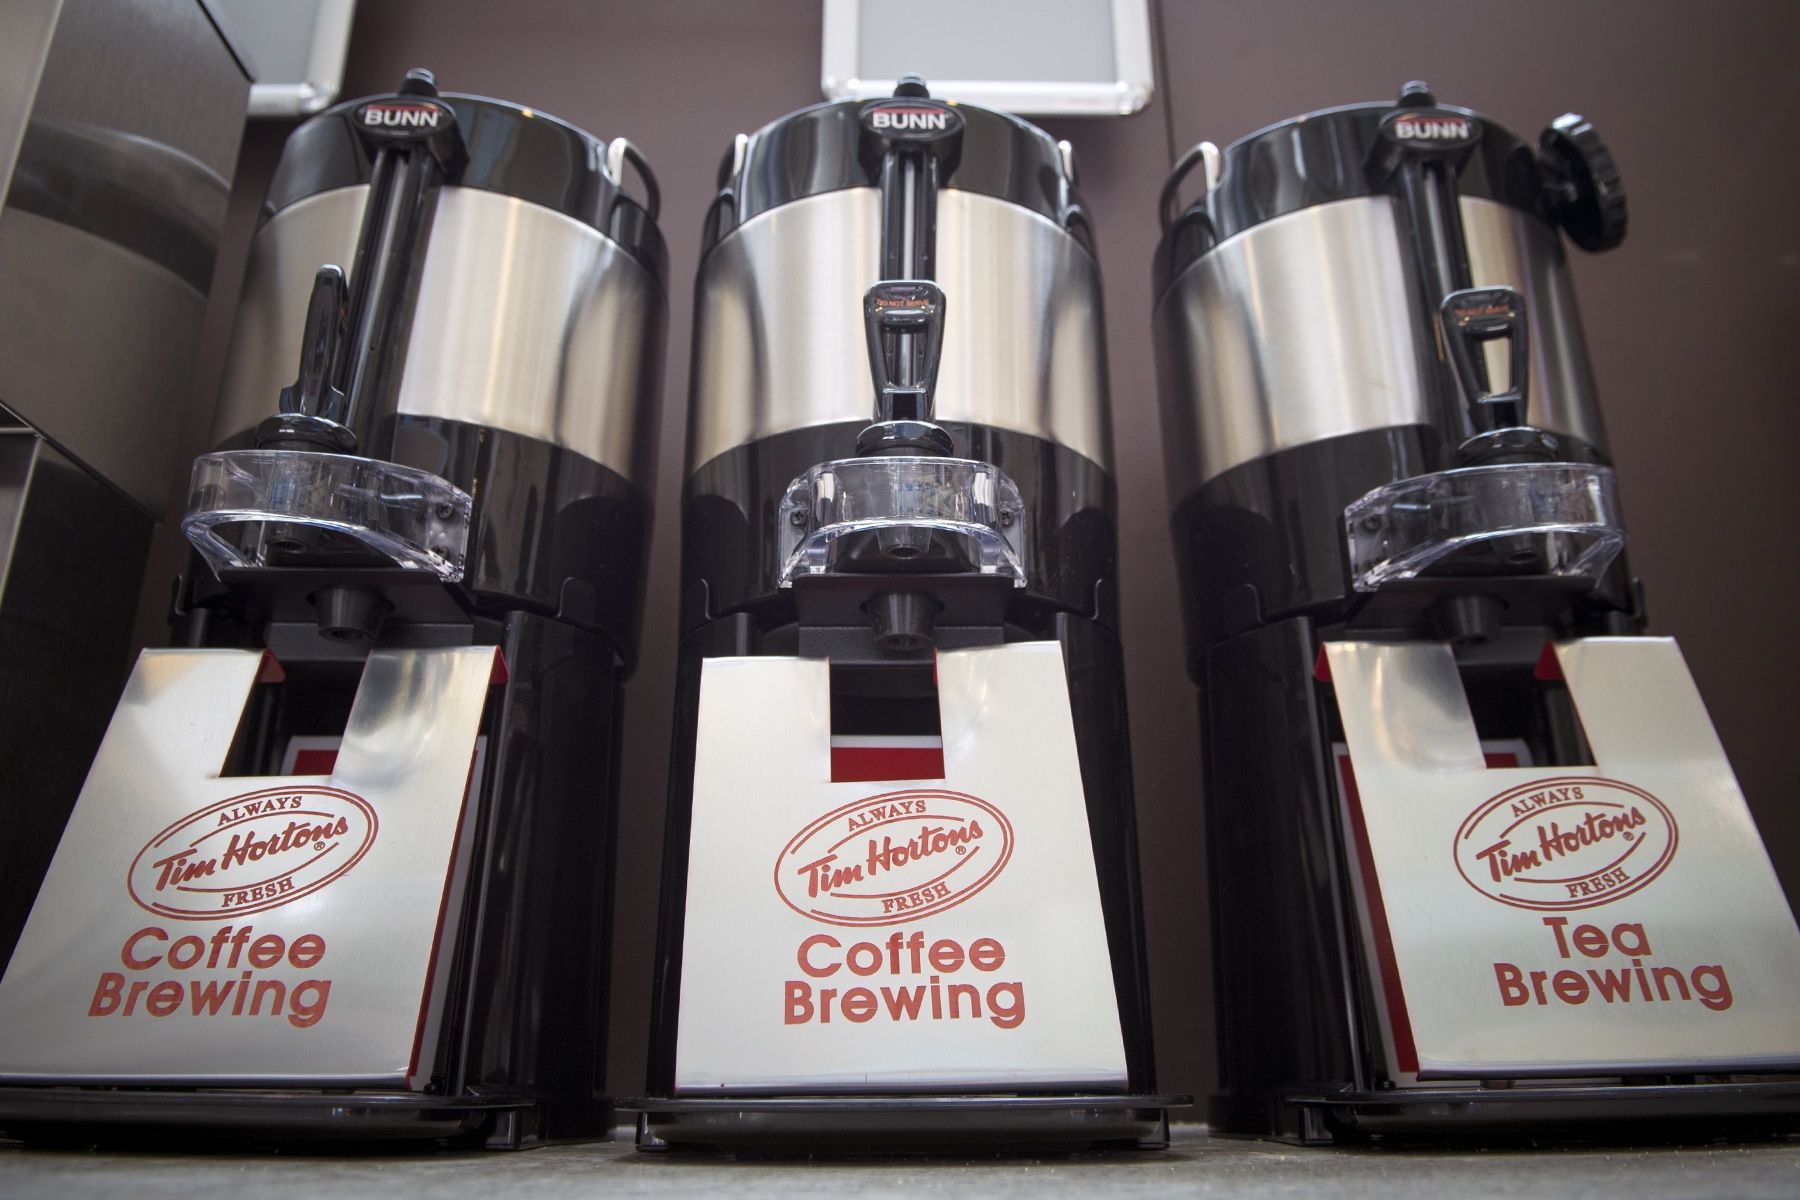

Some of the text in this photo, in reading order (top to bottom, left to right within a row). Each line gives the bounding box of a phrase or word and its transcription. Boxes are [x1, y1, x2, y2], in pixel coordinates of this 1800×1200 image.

[364, 109, 439, 127] BUNN
[872, 112, 946, 130] BUNN
[1395, 121, 1469, 140] BUNN
[889, 300, 905, 308] NOT
[217, 796, 302, 826] ALWAYS
[848, 800, 927, 832] ALWAYS
[1511, 786, 1584, 817] ALWAYS
[153, 816, 349, 891] Tim Hortons
[797, 820, 984, 898] Tim Hortons
[1476, 806, 1647, 882] Tim Hortons
[221, 876, 296, 907] FRESH
[881, 881, 951, 913] FRESH
[1565, 867, 1630, 898] FRESH
[121, 925, 326, 970] Coffee
[1542, 916, 1652, 958] Tea
[797, 931, 1005, 978] Coffee
[87, 971, 332, 1028] Brewing
[1493, 958, 1733, 1011] Brewing
[784, 975, 1026, 1029] Brewing
